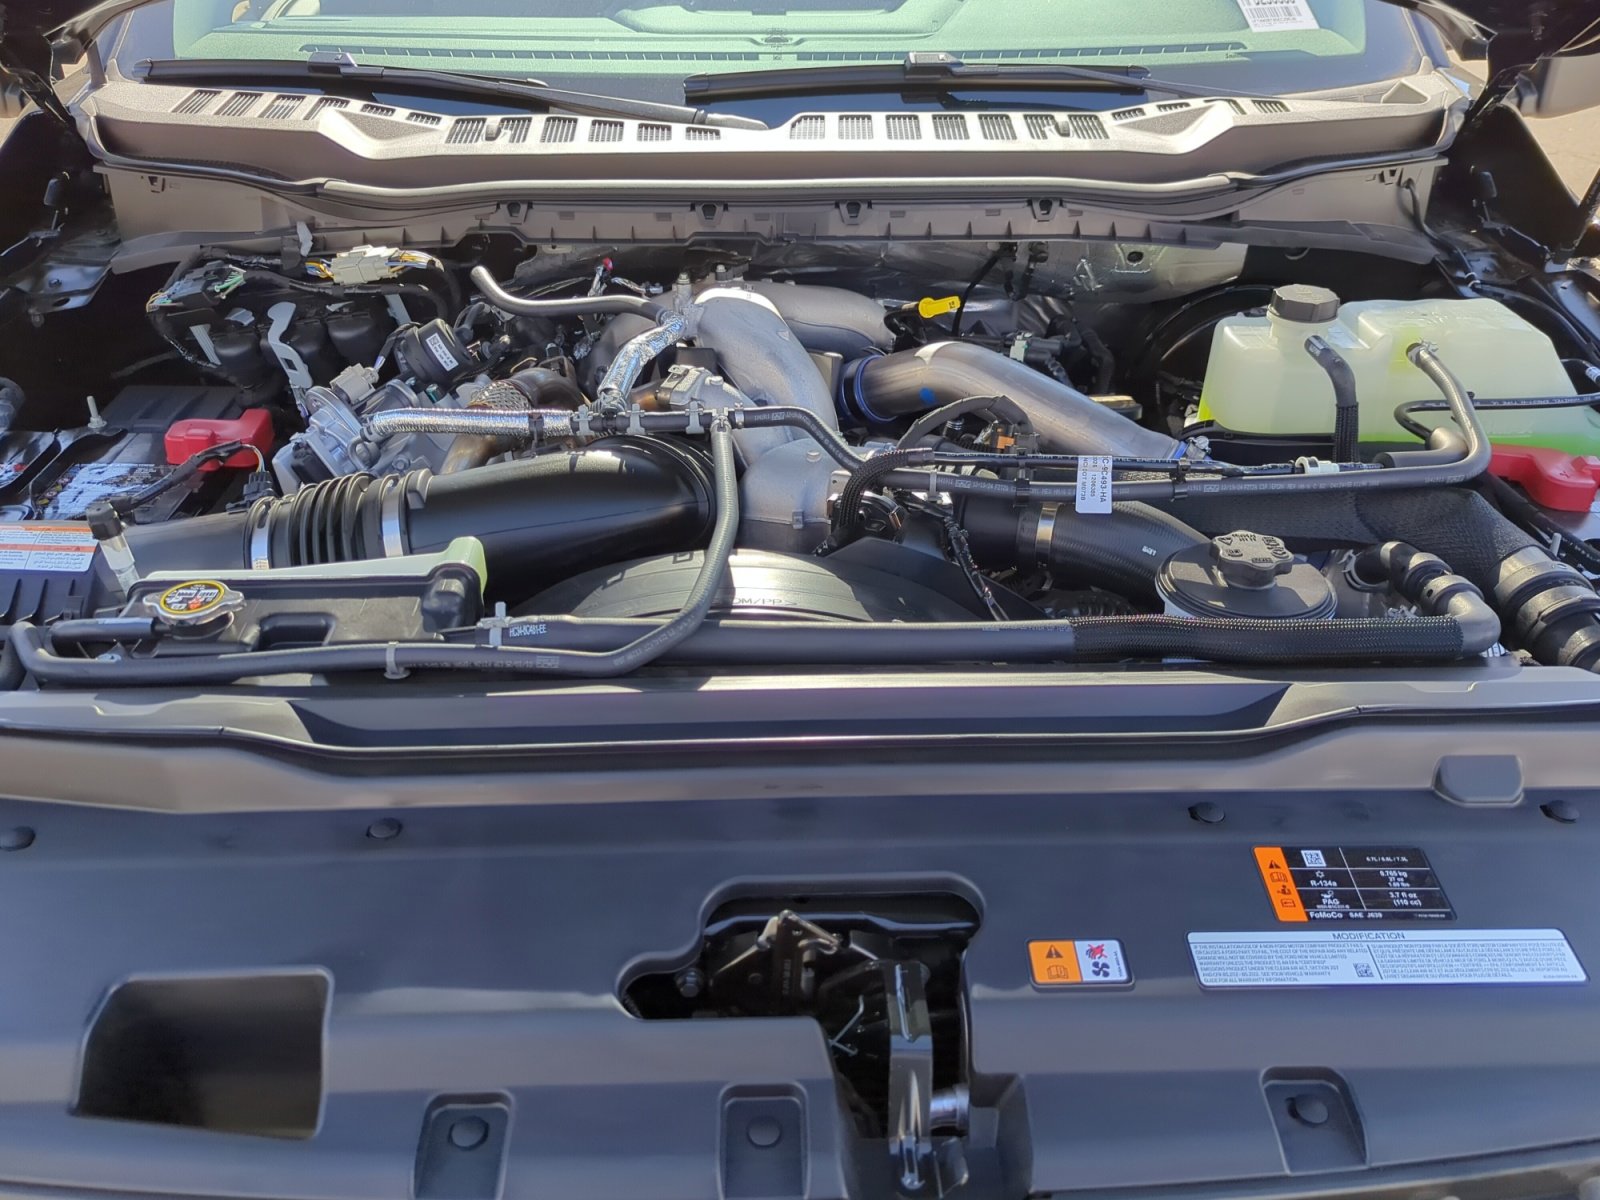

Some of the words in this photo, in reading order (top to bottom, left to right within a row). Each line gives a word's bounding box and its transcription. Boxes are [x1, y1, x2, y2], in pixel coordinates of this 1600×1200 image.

[1310, 879, 1338, 887] R-134a
[1309, 911, 1344, 919] FoMoCo
[1332, 931, 1406, 940] MODIFICATION
